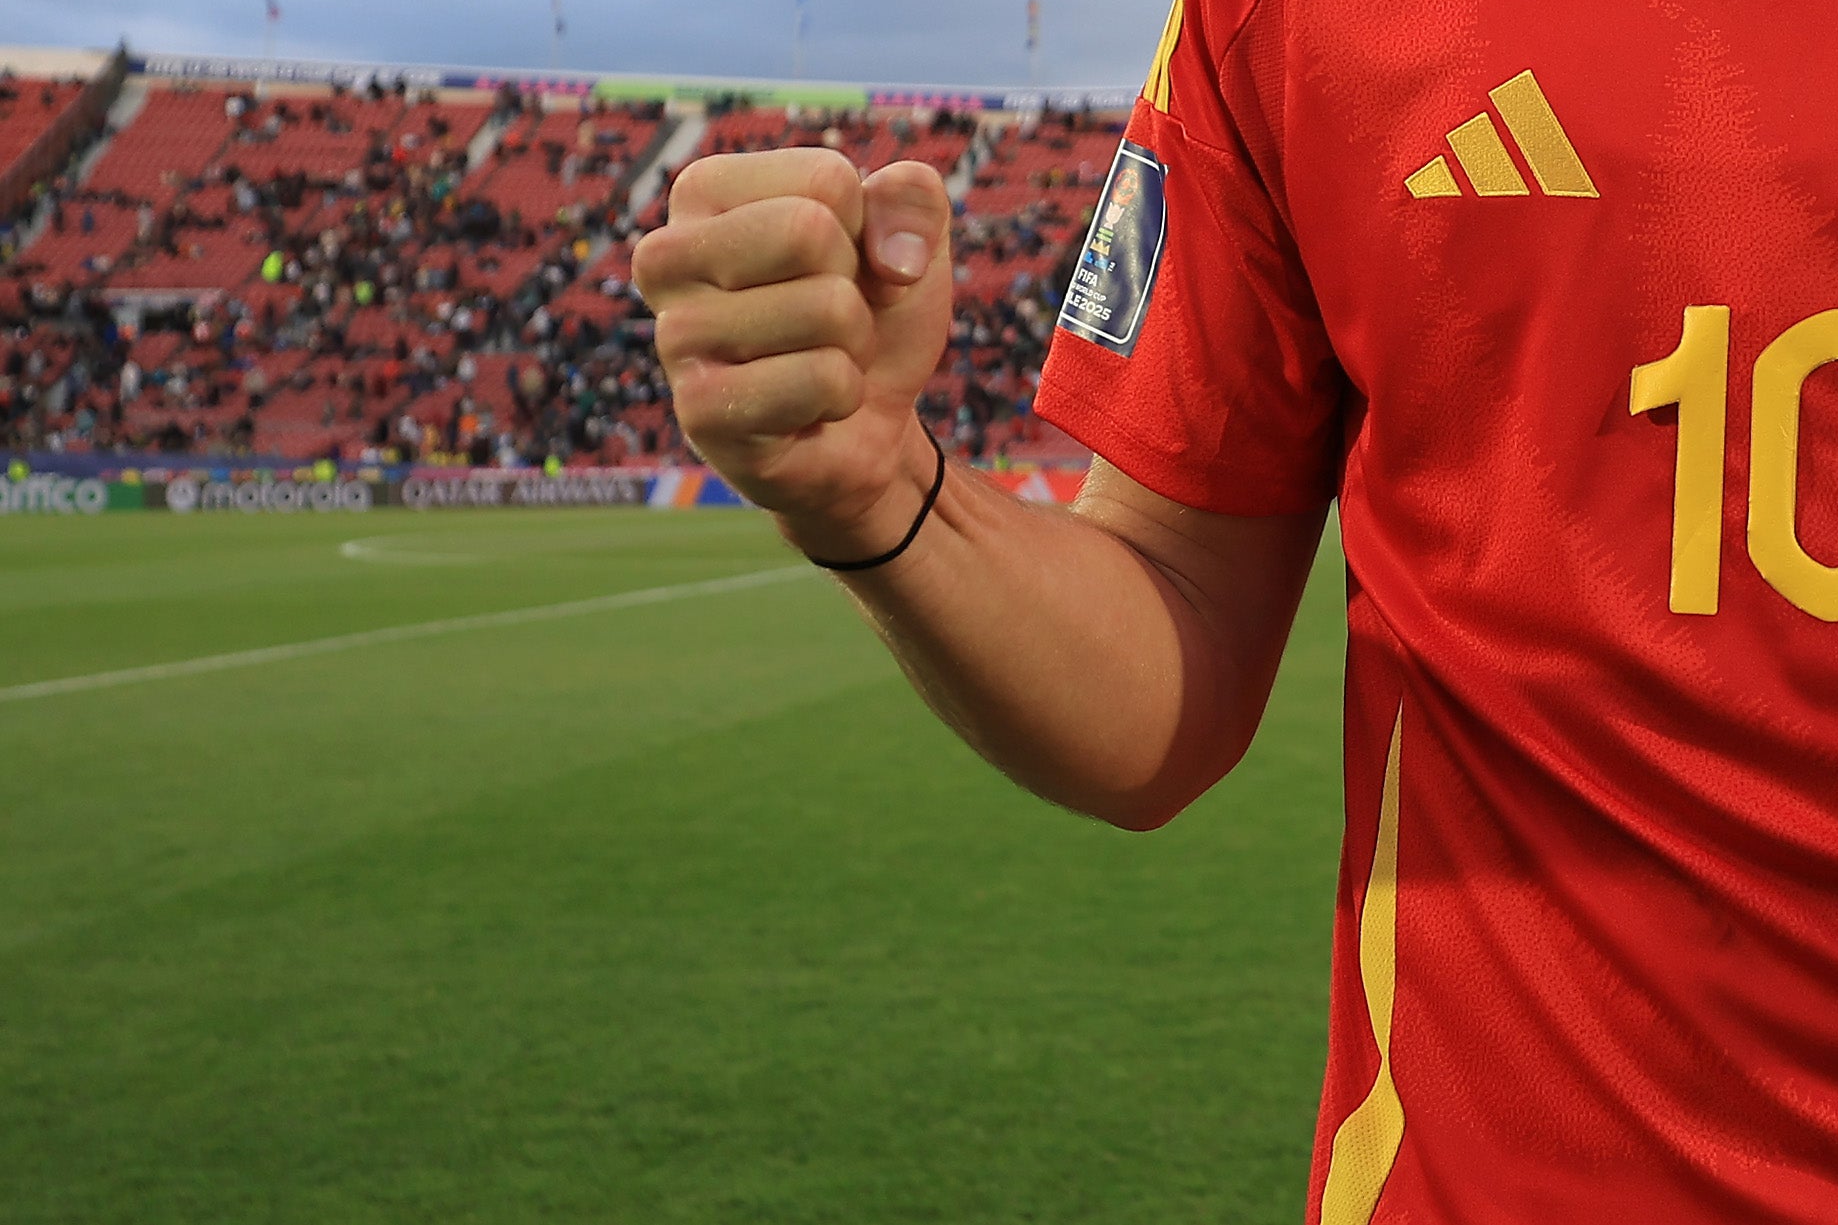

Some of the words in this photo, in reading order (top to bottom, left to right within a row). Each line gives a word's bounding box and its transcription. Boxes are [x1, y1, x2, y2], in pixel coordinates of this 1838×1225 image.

[1077, 268, 1098, 287] FIFA
[1076, 283, 1094, 297] WORLD
[1093, 291, 1107, 302] CUP
[202, 475, 373, 513] motorola
[401, 477, 500, 510] QATAR
[511, 476, 634, 505] AIRWAYS
